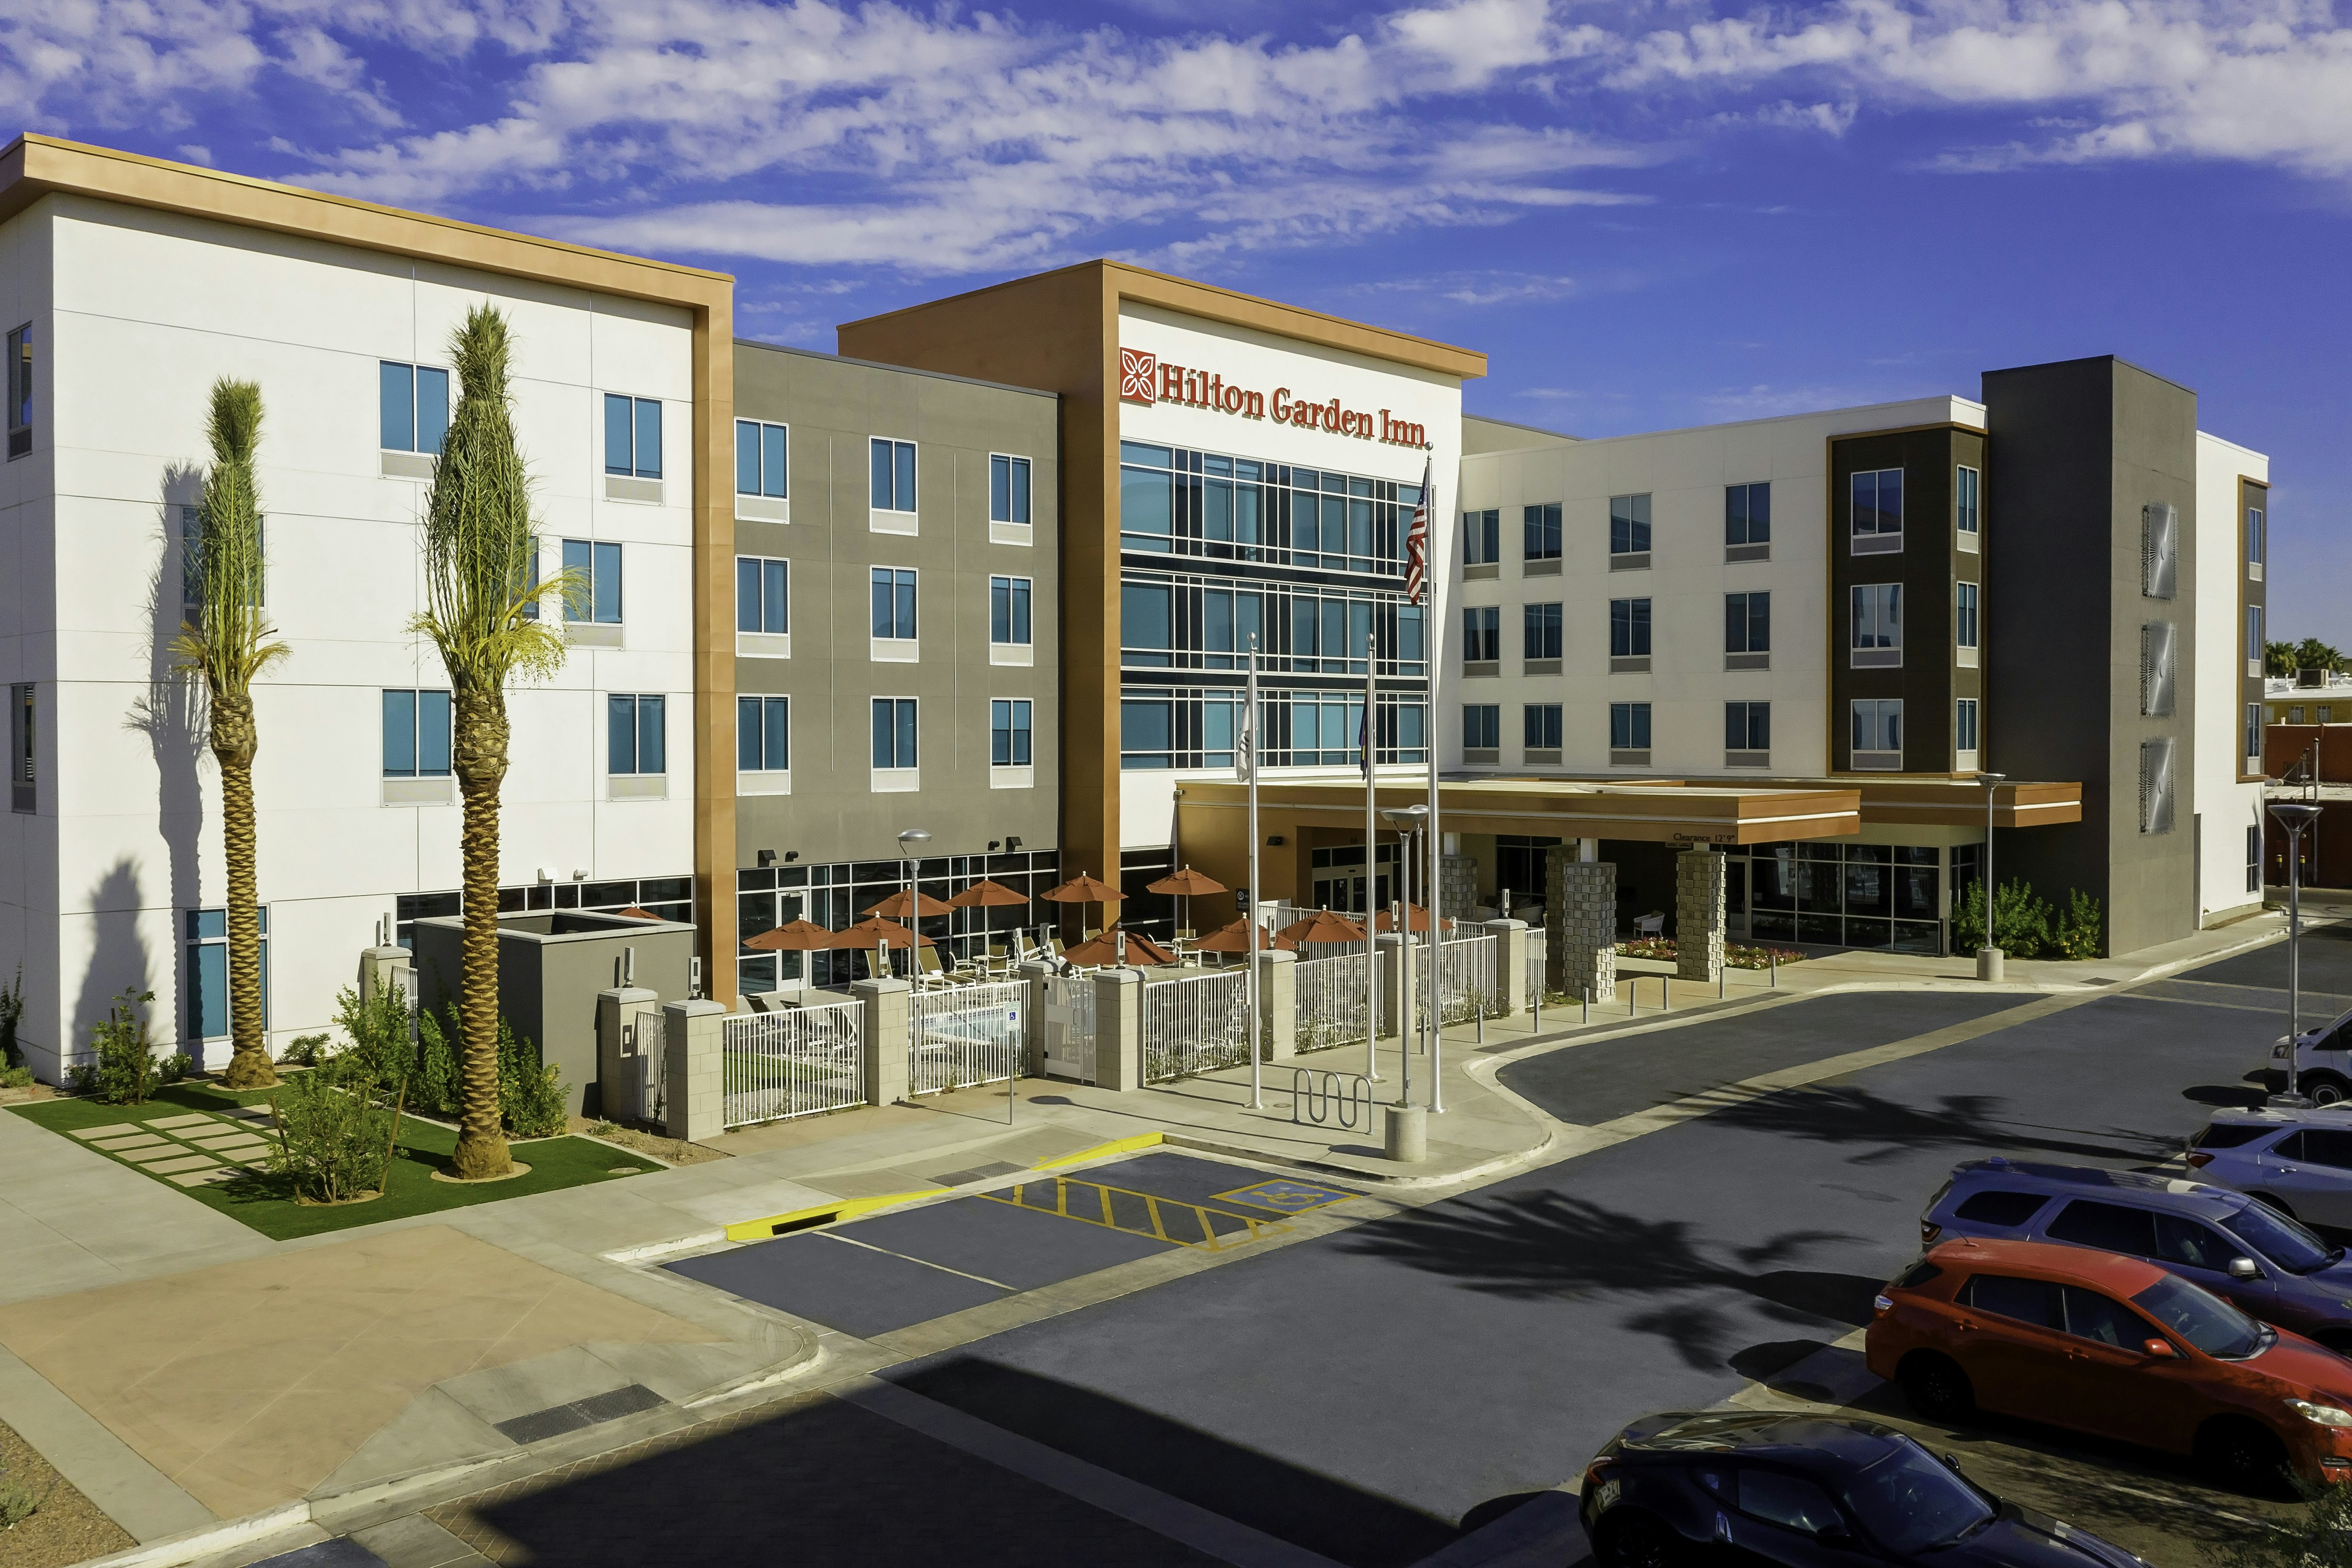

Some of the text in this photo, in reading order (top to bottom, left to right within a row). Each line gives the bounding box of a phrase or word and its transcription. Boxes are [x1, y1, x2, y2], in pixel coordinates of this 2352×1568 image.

[1158, 362, 1425, 446] Hilton Garden Inn
[1673, 833, 1735, 843] Clearance 12'9"
